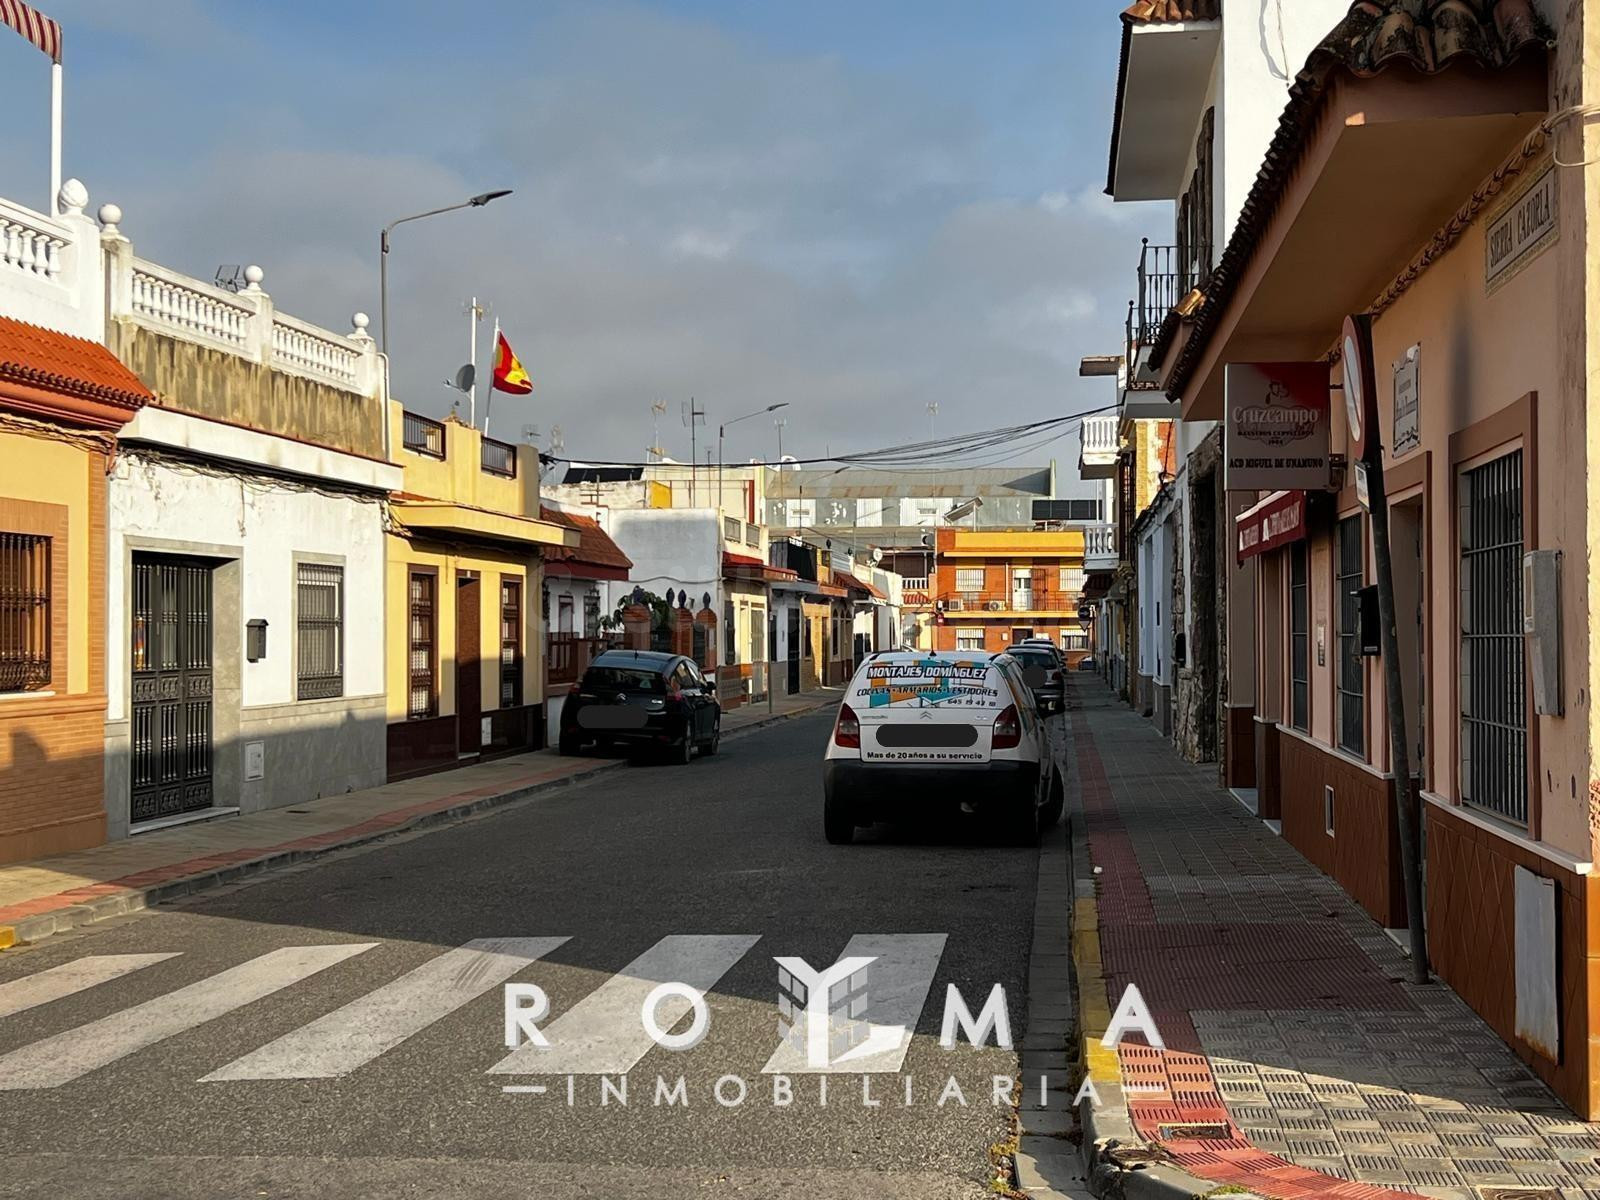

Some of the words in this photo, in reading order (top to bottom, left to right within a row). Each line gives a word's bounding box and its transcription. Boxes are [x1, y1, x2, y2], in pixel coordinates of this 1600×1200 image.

[1490, 217, 1513, 268] SIERRA
[1517, 183, 1550, 245] CAZORLA
[1231, 406, 1319, 426] Cruzcampo
[1229, 458, 1244, 469] ACD
[1245, 458, 1274, 469] MIGUEL
[1275, 458, 1285, 469] DE
[1286, 458, 1324, 469] UNAMUNO
[868, 666, 923, 678] MONTAJES
[924, 666, 987, 680] DOMÍNGUEZ
[857, 687, 891, 697] COCINAS
[949, 752, 983, 760] servicio
